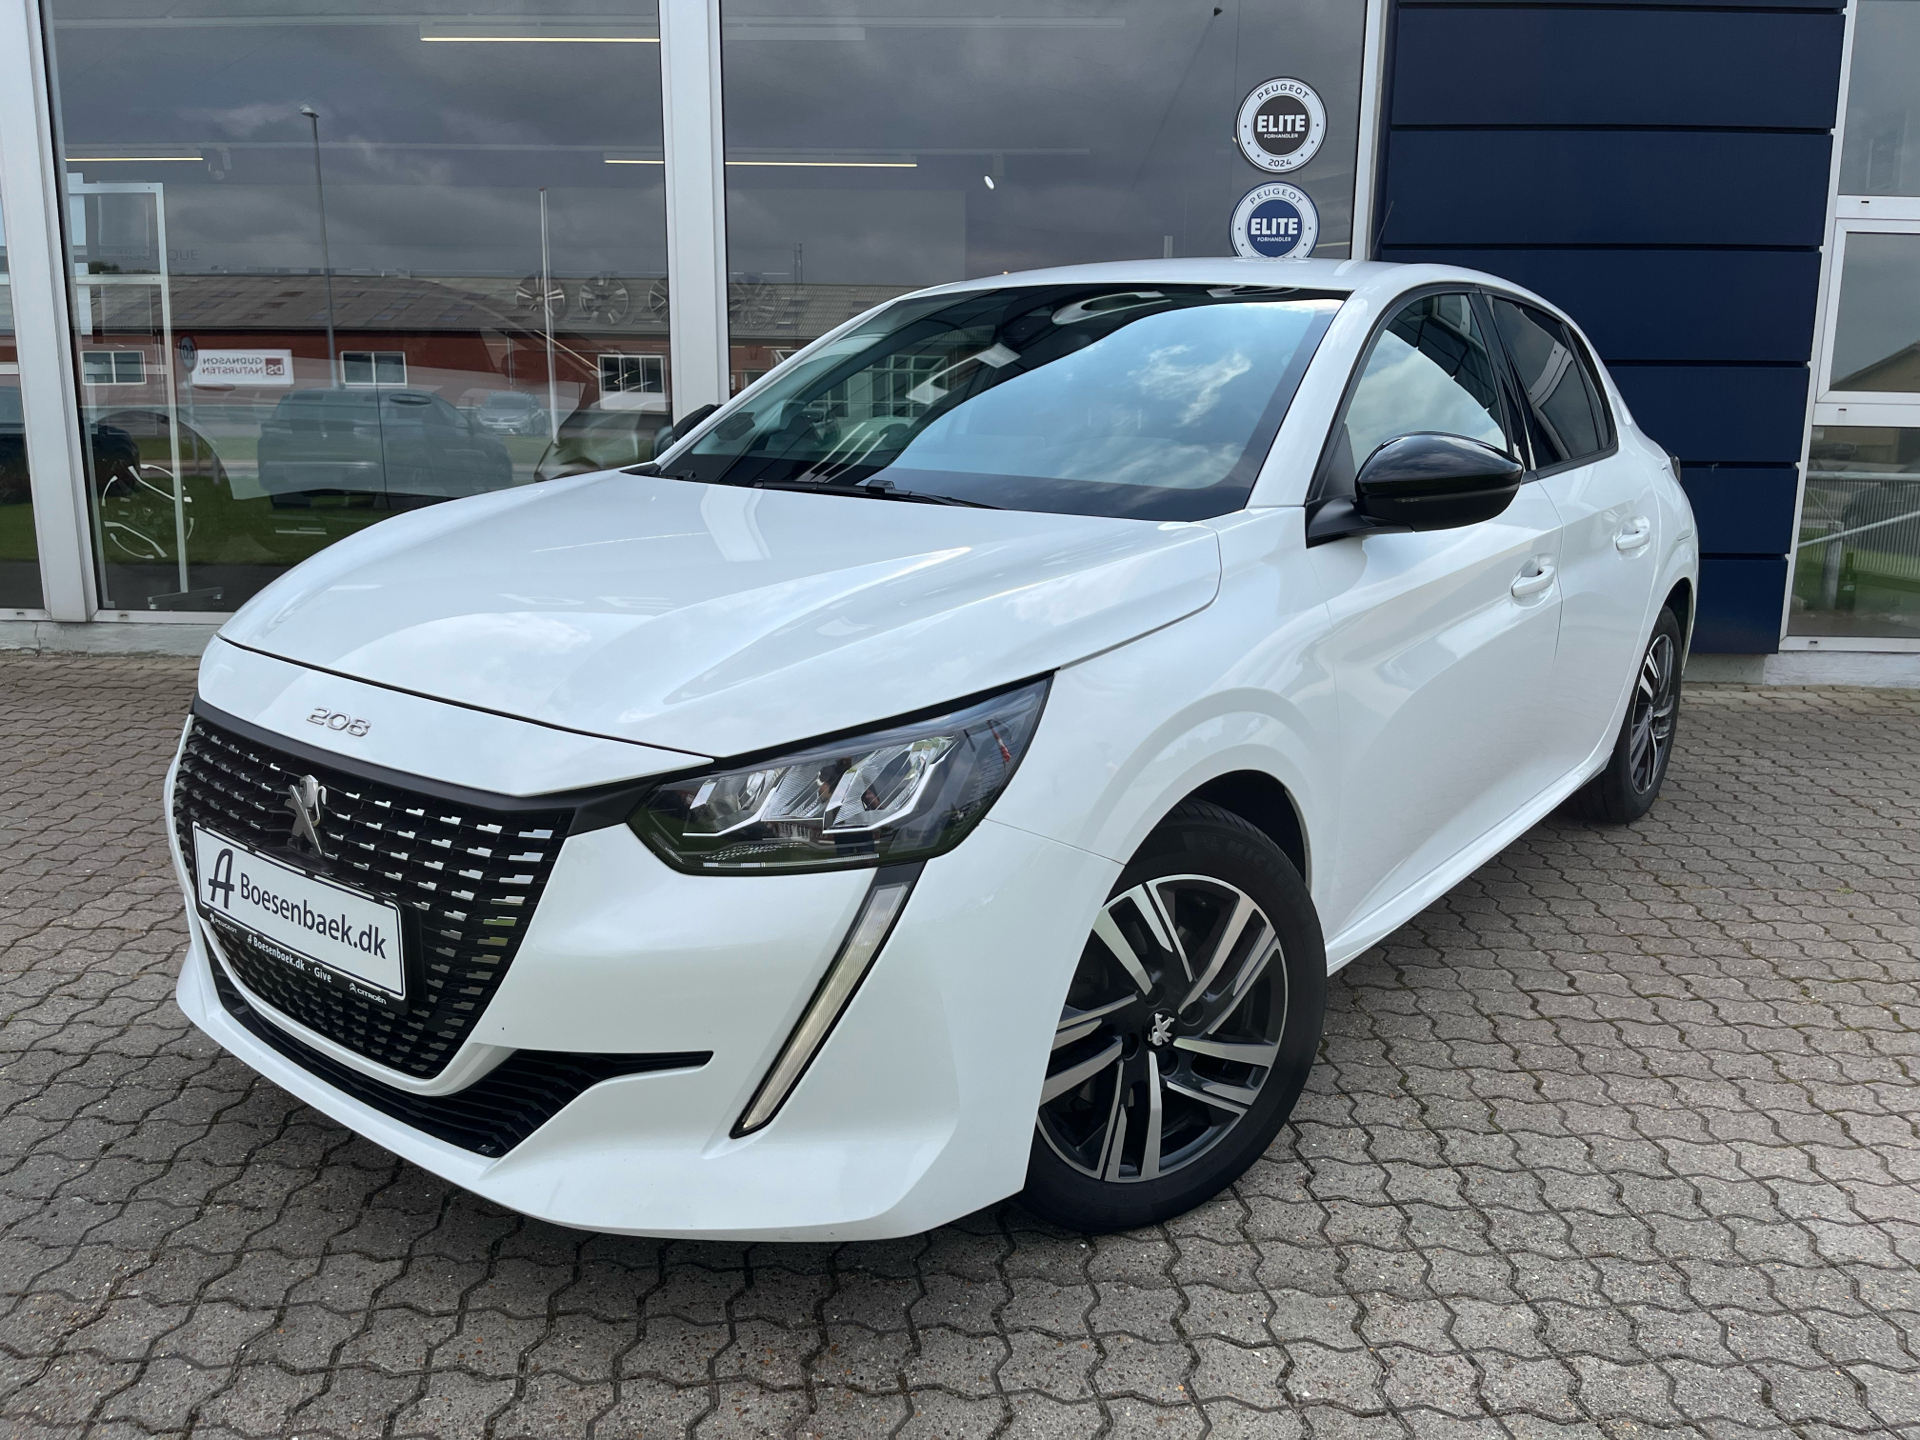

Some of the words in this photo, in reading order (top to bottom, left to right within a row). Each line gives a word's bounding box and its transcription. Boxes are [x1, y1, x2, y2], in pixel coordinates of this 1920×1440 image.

[1256, 83, 1310, 101] PEUGEOT
[1256, 114, 1306, 132] ELITE
[1267, 158, 1292, 168] 2024
[1249, 187, 1304, 205] PEUGEOT
[1250, 217, 1299, 235] ELITE
[119, 249, 199, 262] BOUTQUE
[306, 706, 372, 737] 208
[240, 871, 387, 960] Boesenbaek.dk
[253, 936, 306, 972] Boesenbaek.dk
[313, 966, 333, 984] Give
